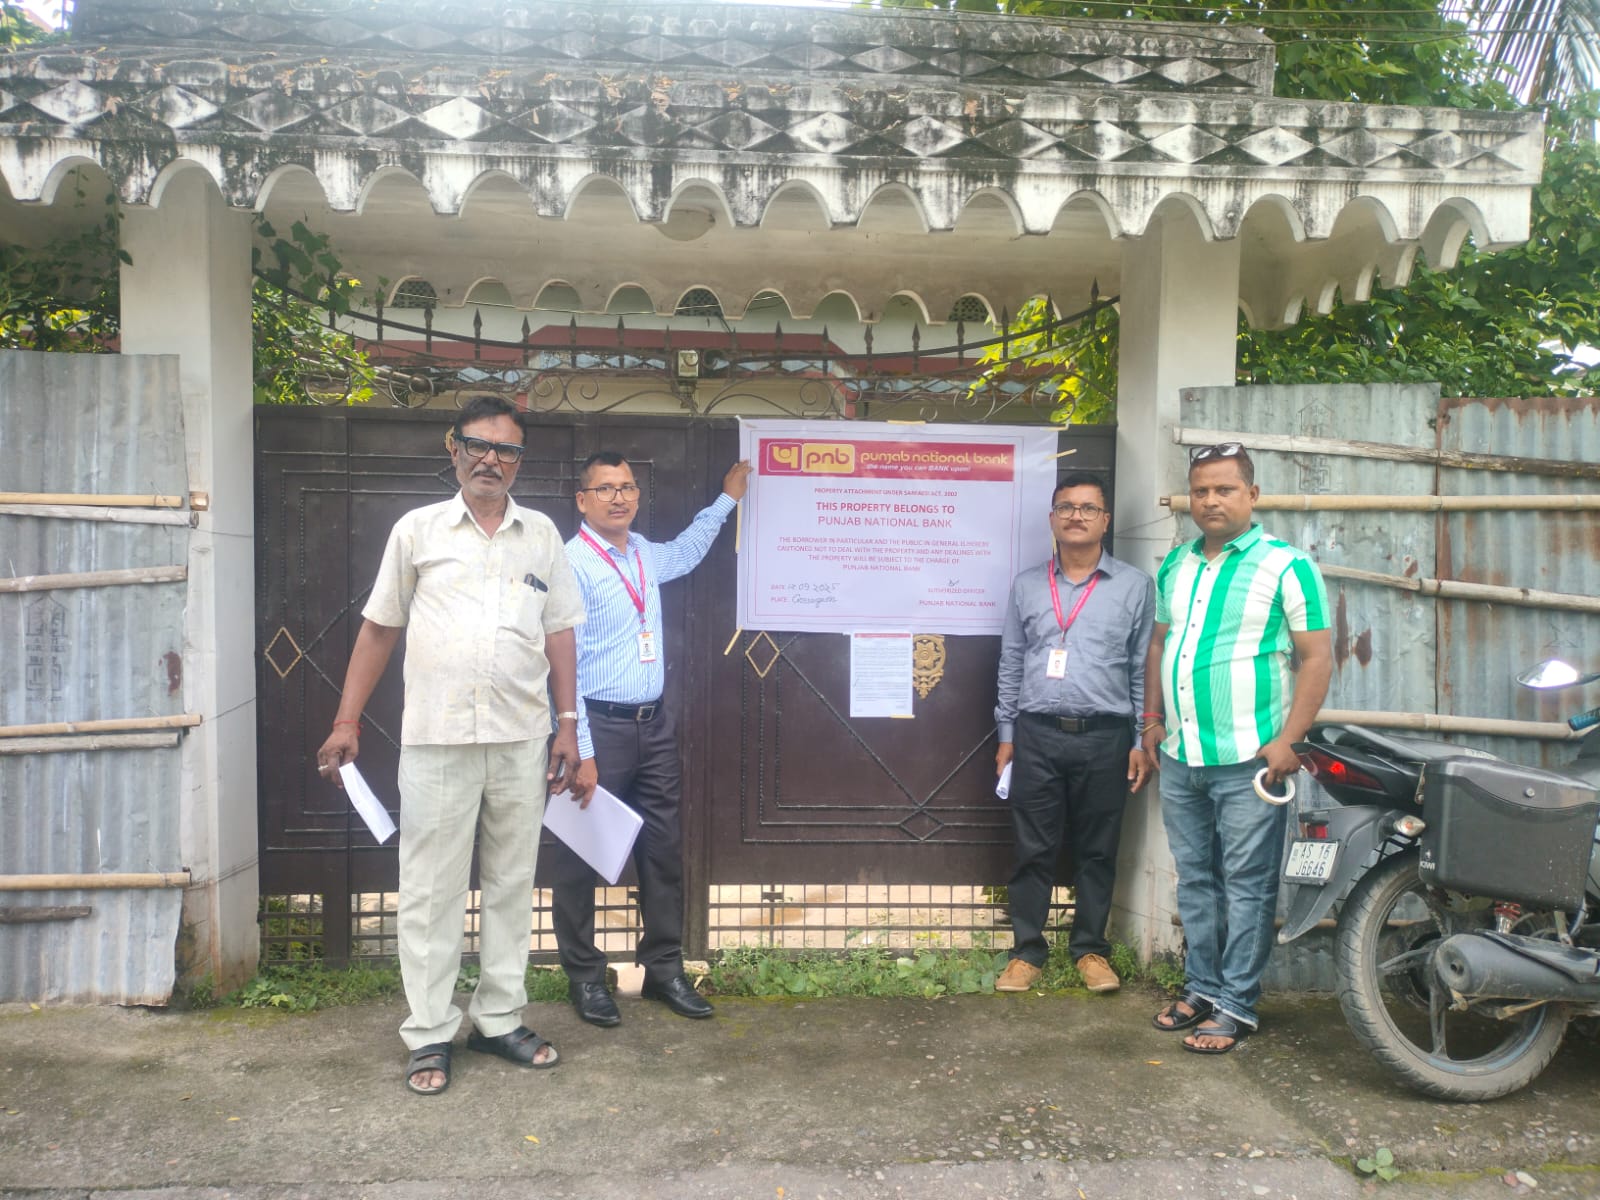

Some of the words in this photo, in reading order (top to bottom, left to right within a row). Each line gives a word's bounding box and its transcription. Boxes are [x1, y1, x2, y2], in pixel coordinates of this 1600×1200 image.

[807, 447, 850, 469] pnb
[861, 450, 910, 465] punjab
[912, 450, 970, 464] national
[973, 452, 1009, 465] bank
[899, 464, 912, 473] you
[816, 502, 838, 511] THIS
[840, 502, 891, 513] PROPERTY
[893, 504, 939, 514] BELONGS
[942, 505, 955, 514] TO
[818, 516, 862, 526] PUNJAB
[865, 517, 919, 528] NATIONAL
[922, 519, 952, 529] BANK
[836, 537, 873, 545] PARTICULAR
[1301, 843, 1314, 860] AS
